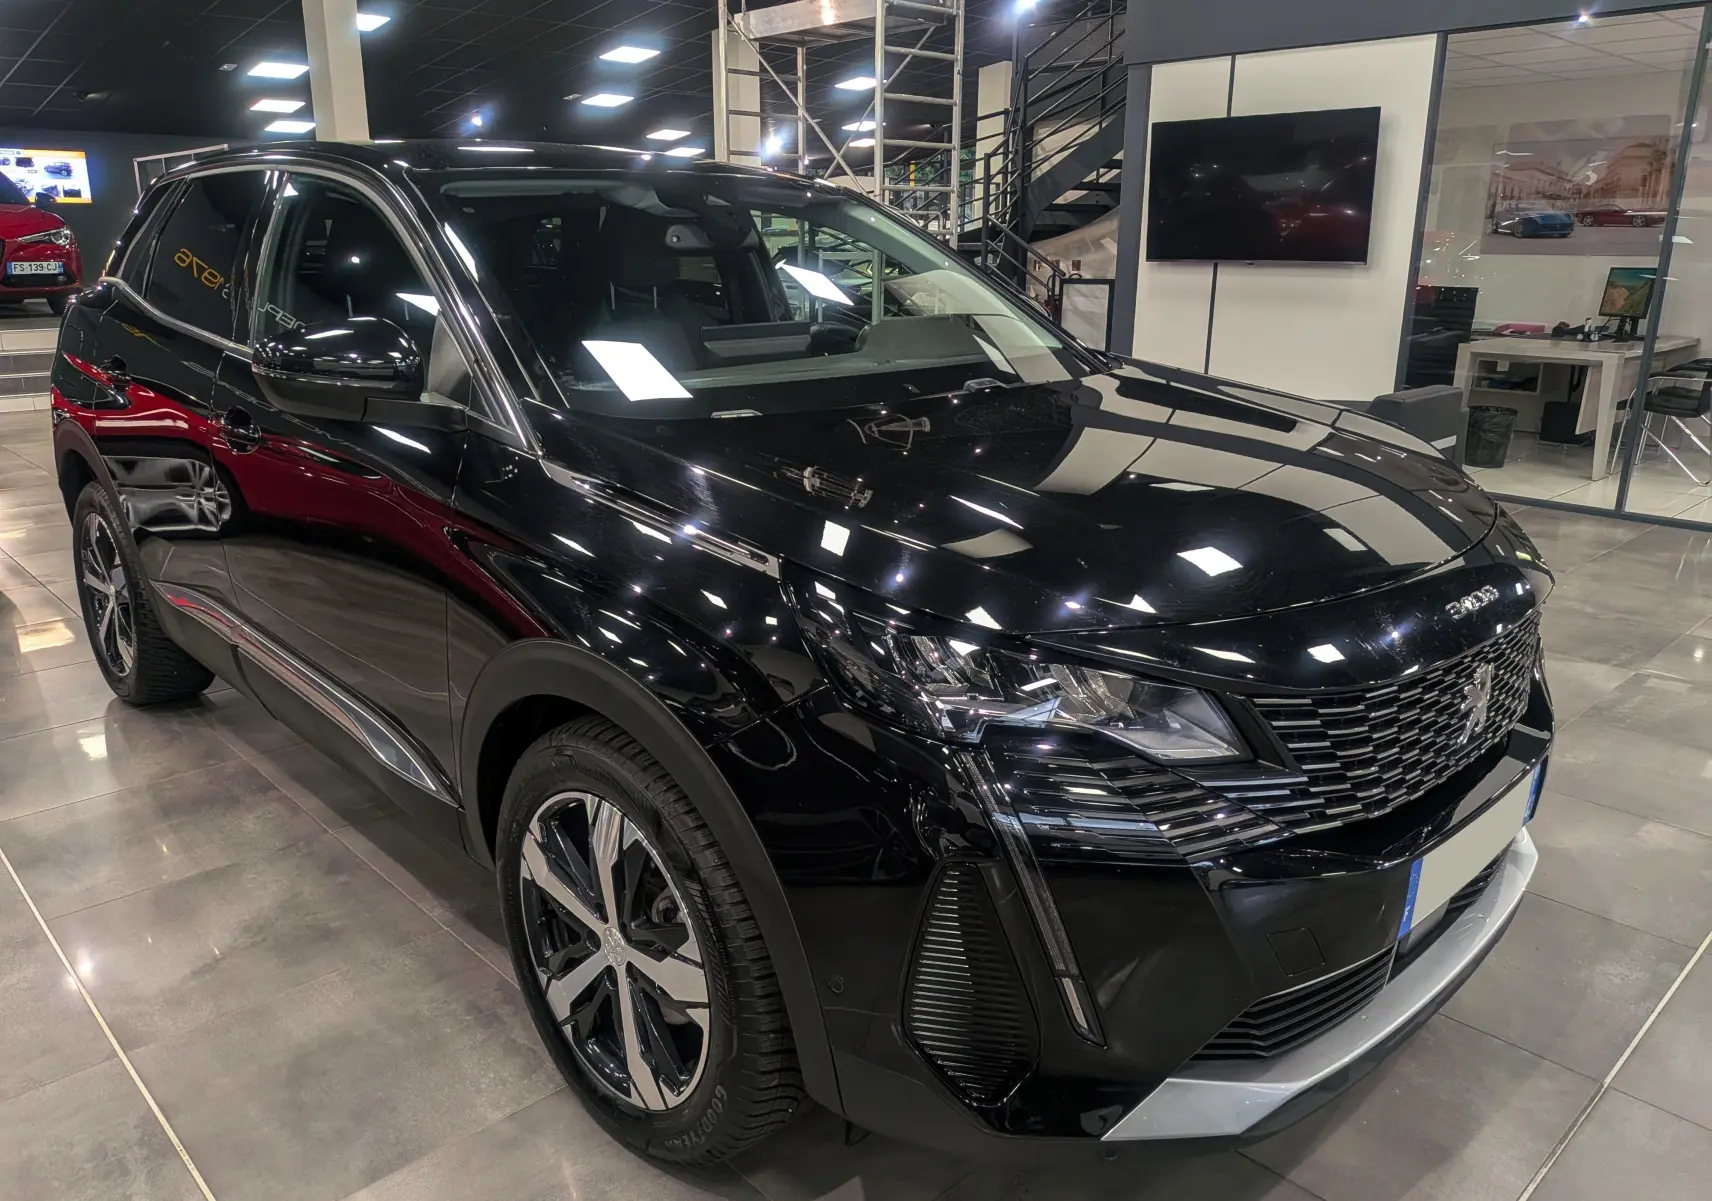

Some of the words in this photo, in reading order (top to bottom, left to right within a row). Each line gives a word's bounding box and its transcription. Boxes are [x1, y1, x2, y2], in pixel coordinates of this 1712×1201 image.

[13, 263, 57, 272] FS-139-CJ
[1445, 585, 1499, 619] 3008
[664, 1085, 728, 1153] GOODYEAR
